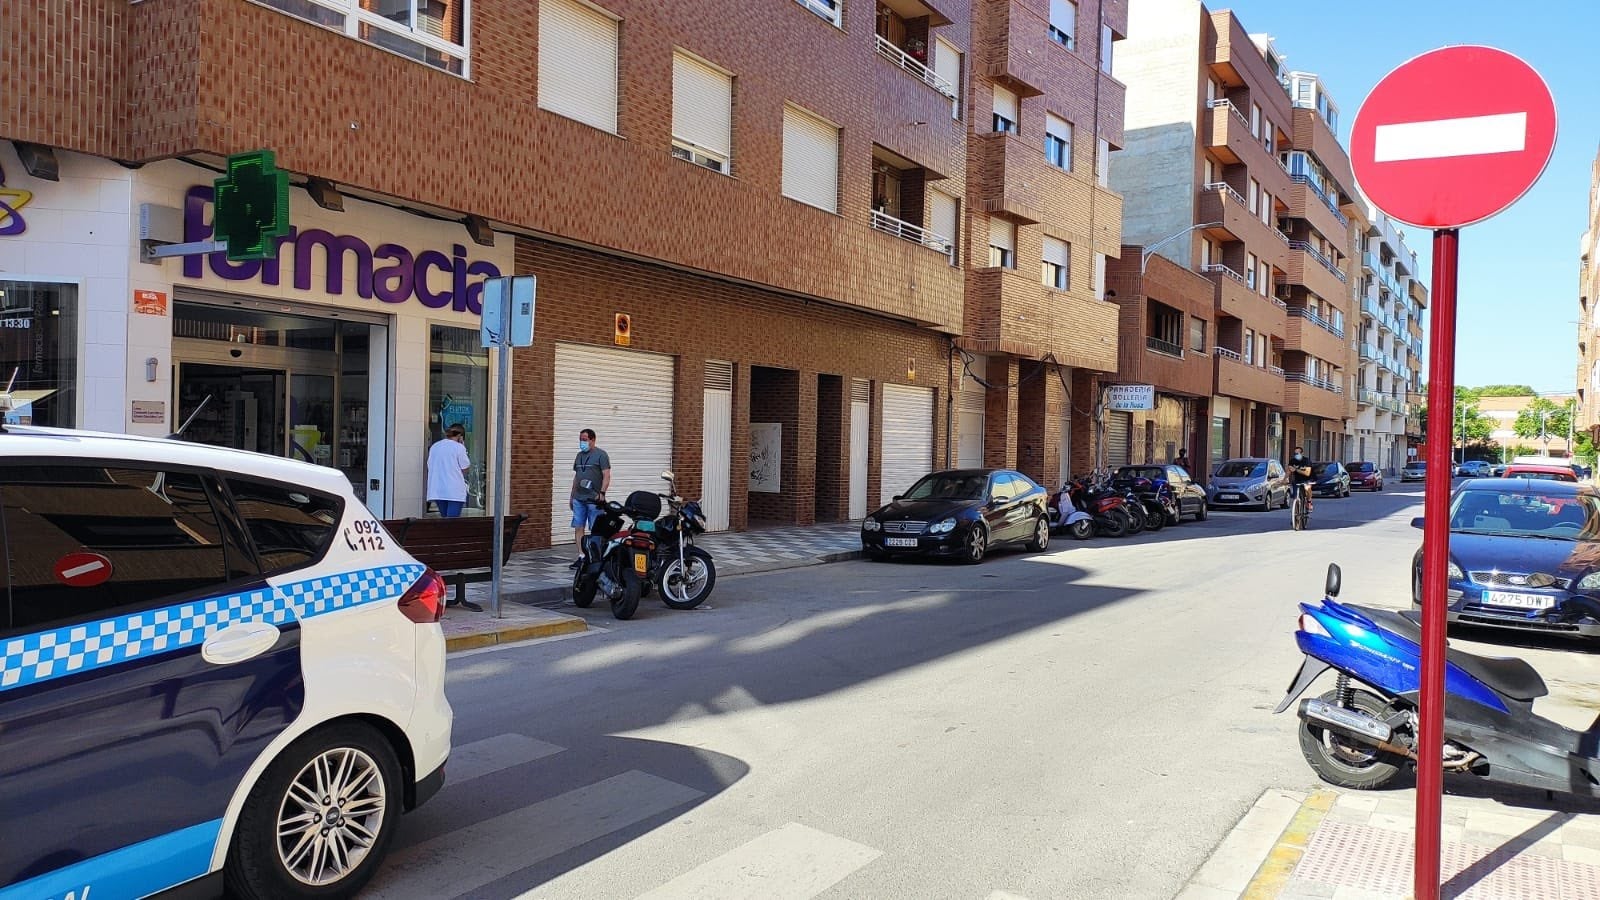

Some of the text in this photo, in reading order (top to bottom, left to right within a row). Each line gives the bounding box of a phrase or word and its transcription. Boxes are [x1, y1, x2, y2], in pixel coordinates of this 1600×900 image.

[5, 319, 30, 329] 13:30
[354, 520, 380, 534] 092
[358, 536, 385, 551] 112
[1491, 592, 1552, 607] 4275 DWT
